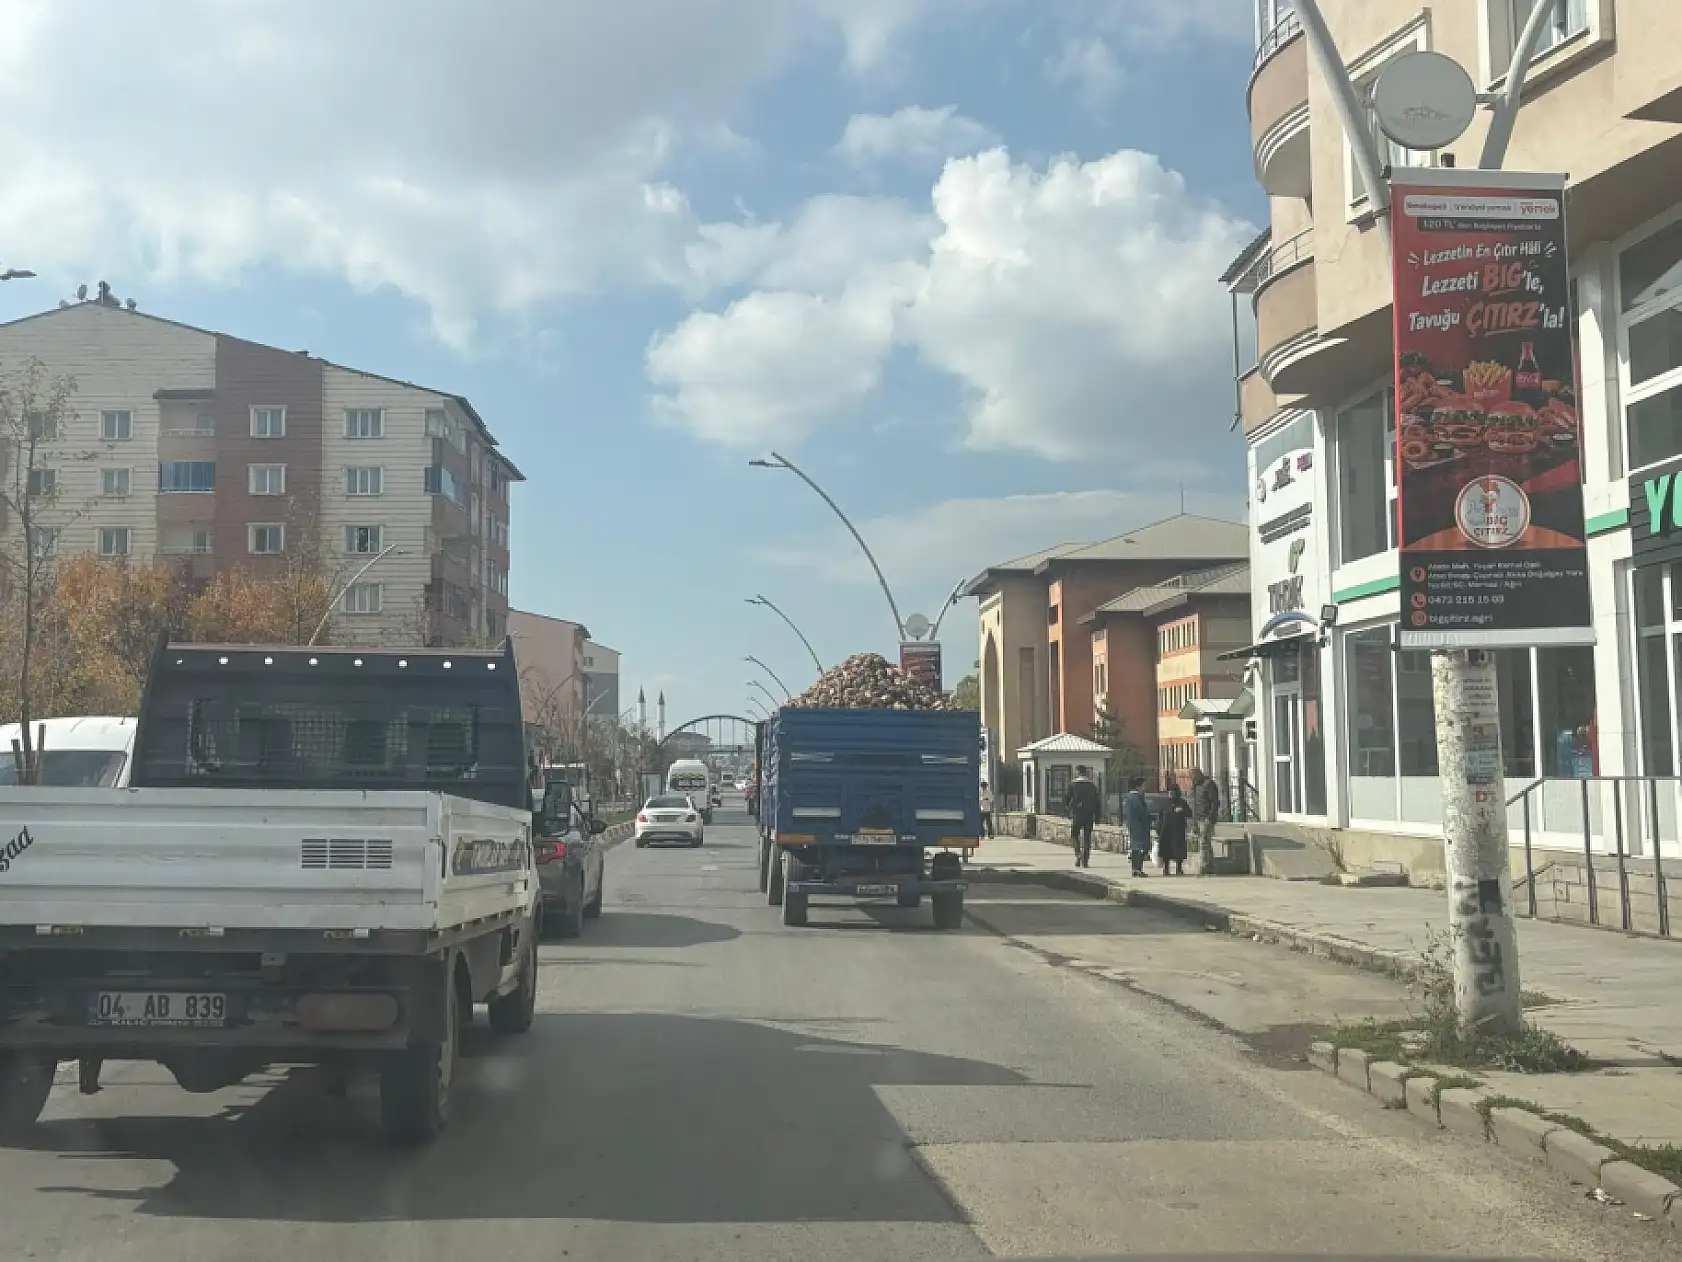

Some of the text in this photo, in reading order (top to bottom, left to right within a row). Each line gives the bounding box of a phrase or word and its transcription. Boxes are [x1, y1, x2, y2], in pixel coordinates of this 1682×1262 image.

[1423, 244, 1473, 266] Lezzetin
[1476, 243, 1490, 258] En
[1422, 272, 1478, 297] Lezzeti
[1409, 308, 1460, 332] Tavuğu
[100, 994, 125, 1018] 04
[185, 994, 224, 1018] 839
